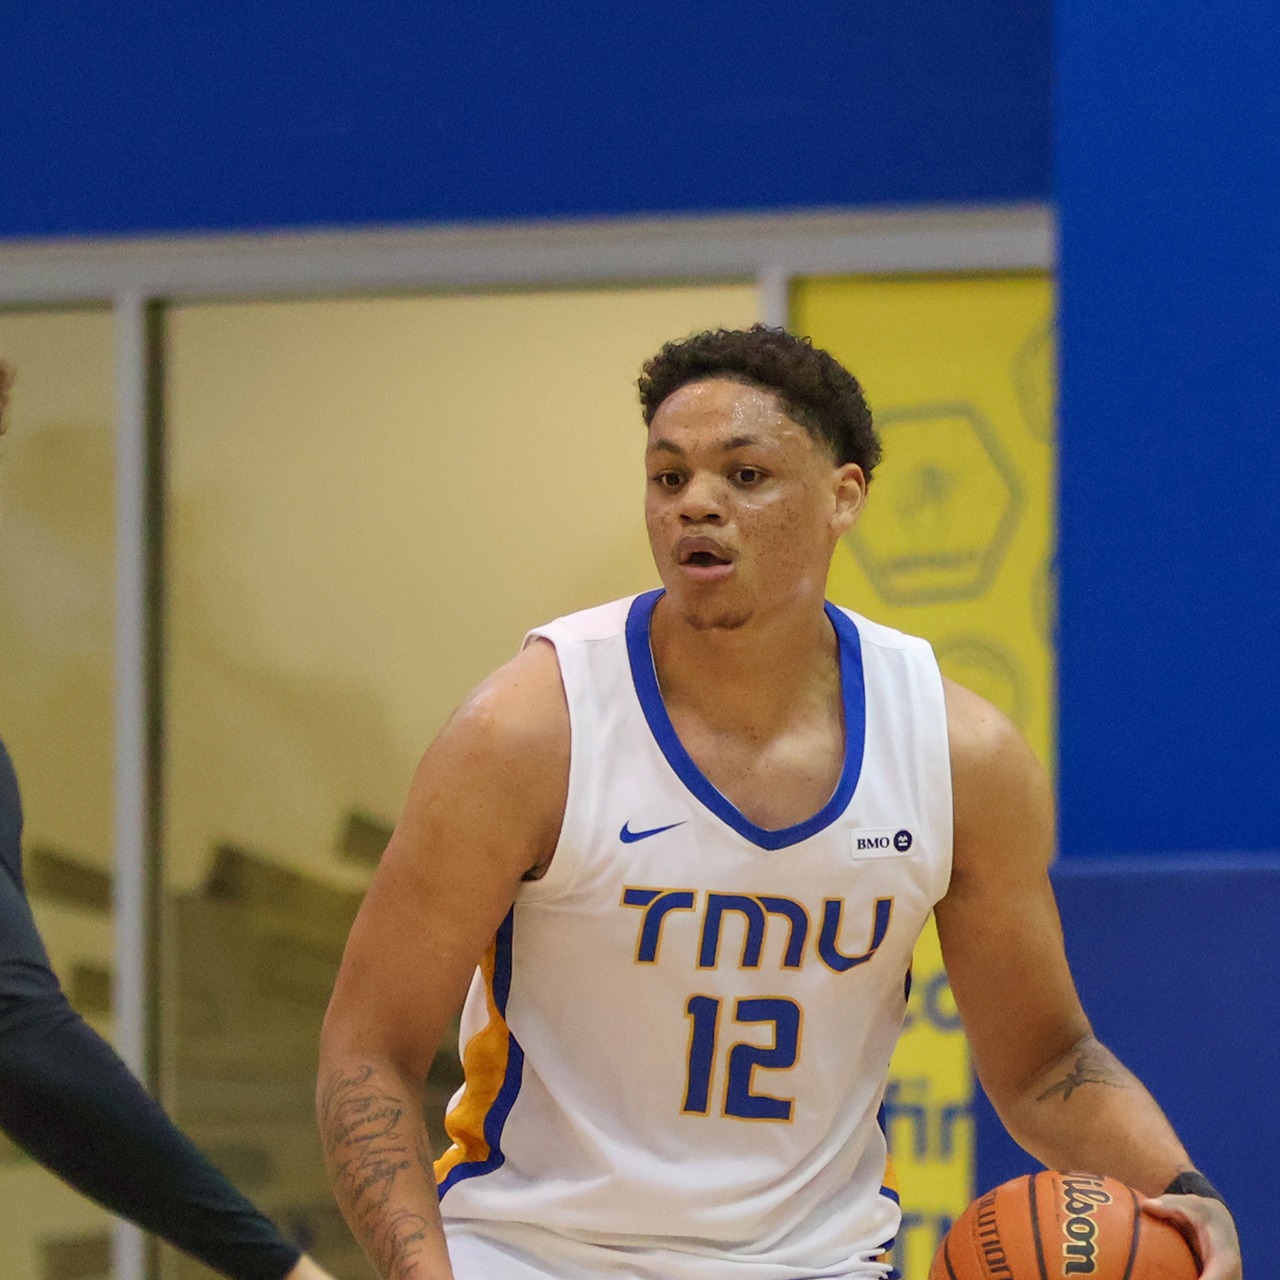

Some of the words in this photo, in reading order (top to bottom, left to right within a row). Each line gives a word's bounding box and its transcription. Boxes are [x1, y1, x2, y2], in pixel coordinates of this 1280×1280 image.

[856, 836, 890, 850] BMO
[619, 884, 895, 975] TMU
[679, 992, 803, 1125] 12
[1061, 1171, 1114, 1278] ilson
